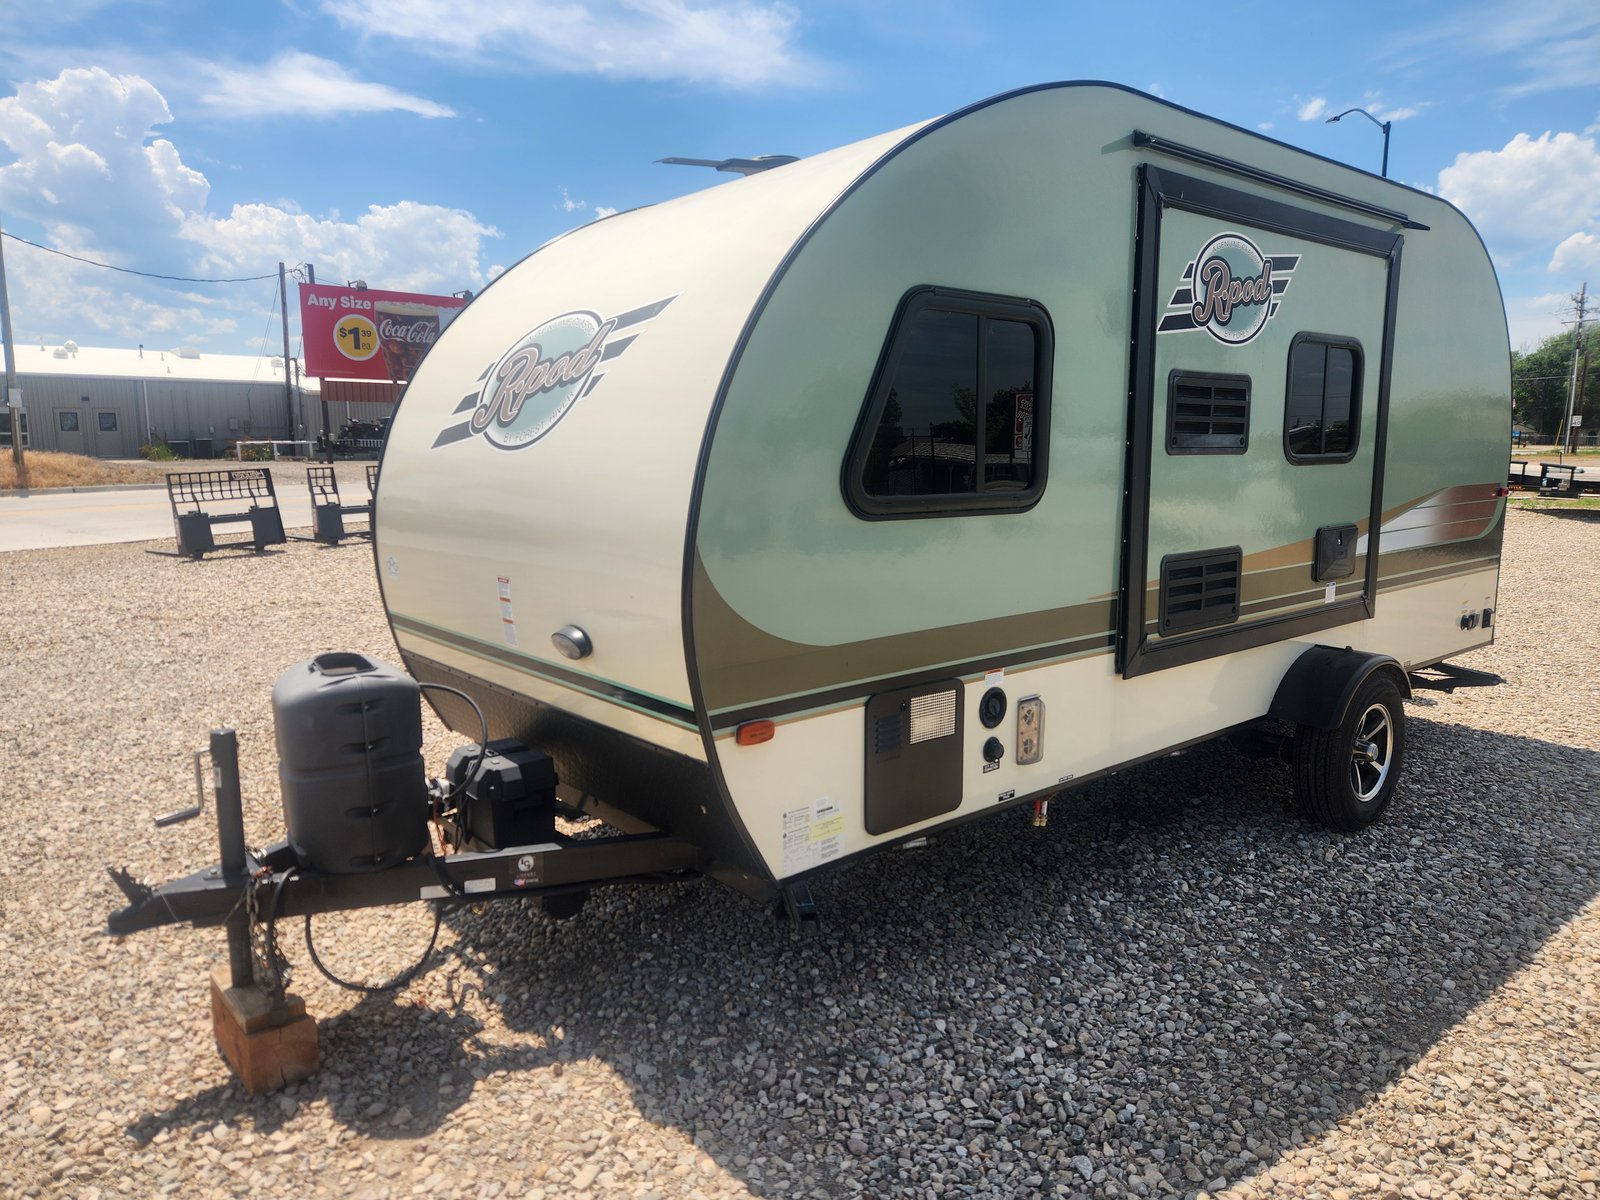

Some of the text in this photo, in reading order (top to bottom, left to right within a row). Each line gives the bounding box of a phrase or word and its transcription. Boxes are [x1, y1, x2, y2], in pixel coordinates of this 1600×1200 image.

[307, 293, 372, 310] Any Size
[515, 421, 544, 442] FOREST
